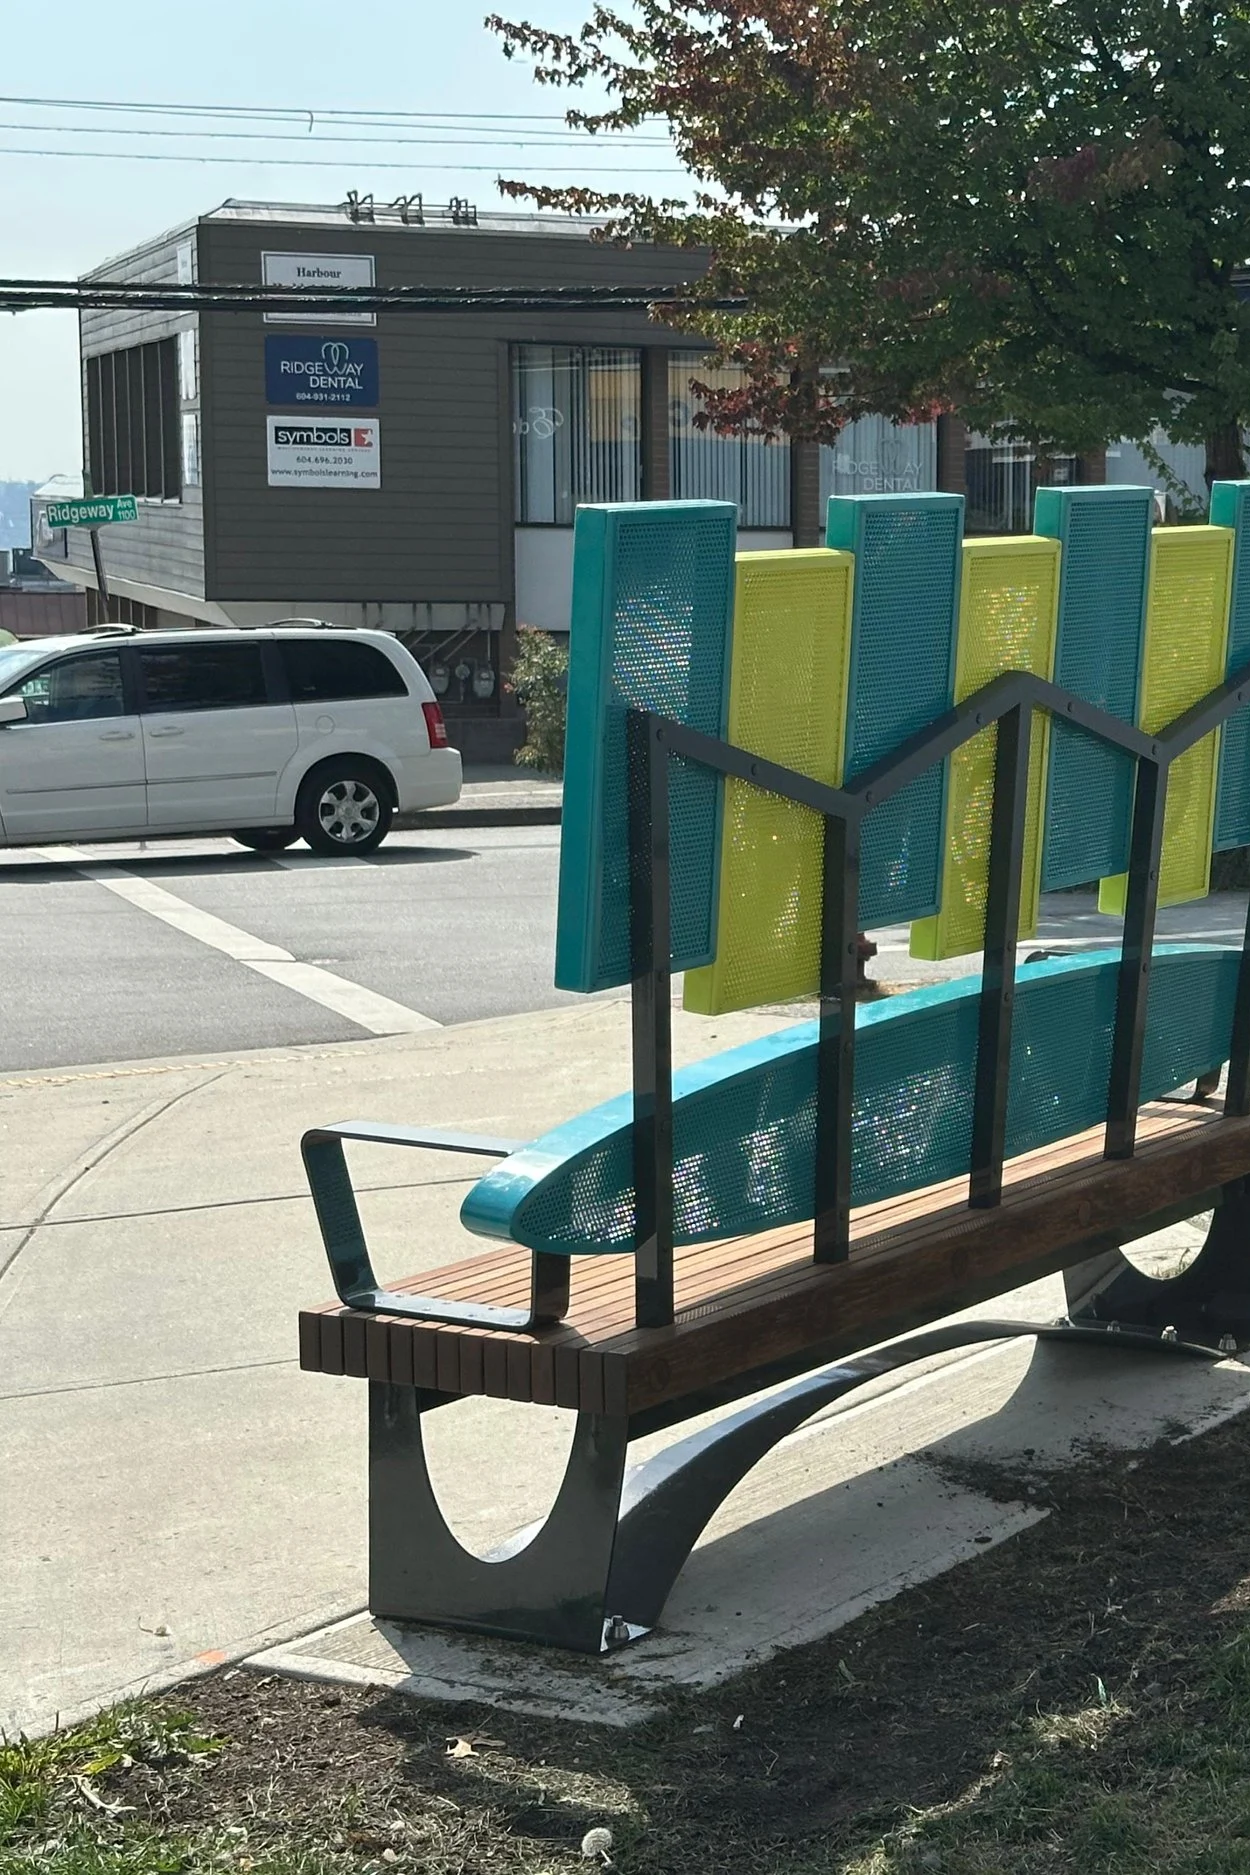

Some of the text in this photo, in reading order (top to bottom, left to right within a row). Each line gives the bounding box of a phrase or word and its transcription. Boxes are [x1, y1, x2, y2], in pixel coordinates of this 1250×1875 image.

[297, 267, 341, 278] Harbour
[281, 360, 364, 376] RIDGEWAY
[310, 376, 363, 389] DENTAL
[278, 427, 349, 446] symbols
[271, 468, 378, 478] www.symbolslearning.com
[863, 477, 922, 491] DENTAL
[116, 499, 132, 509] Ave
[48, 504, 113, 524] Ridgeway
[118, 510, 135, 520] 1100
